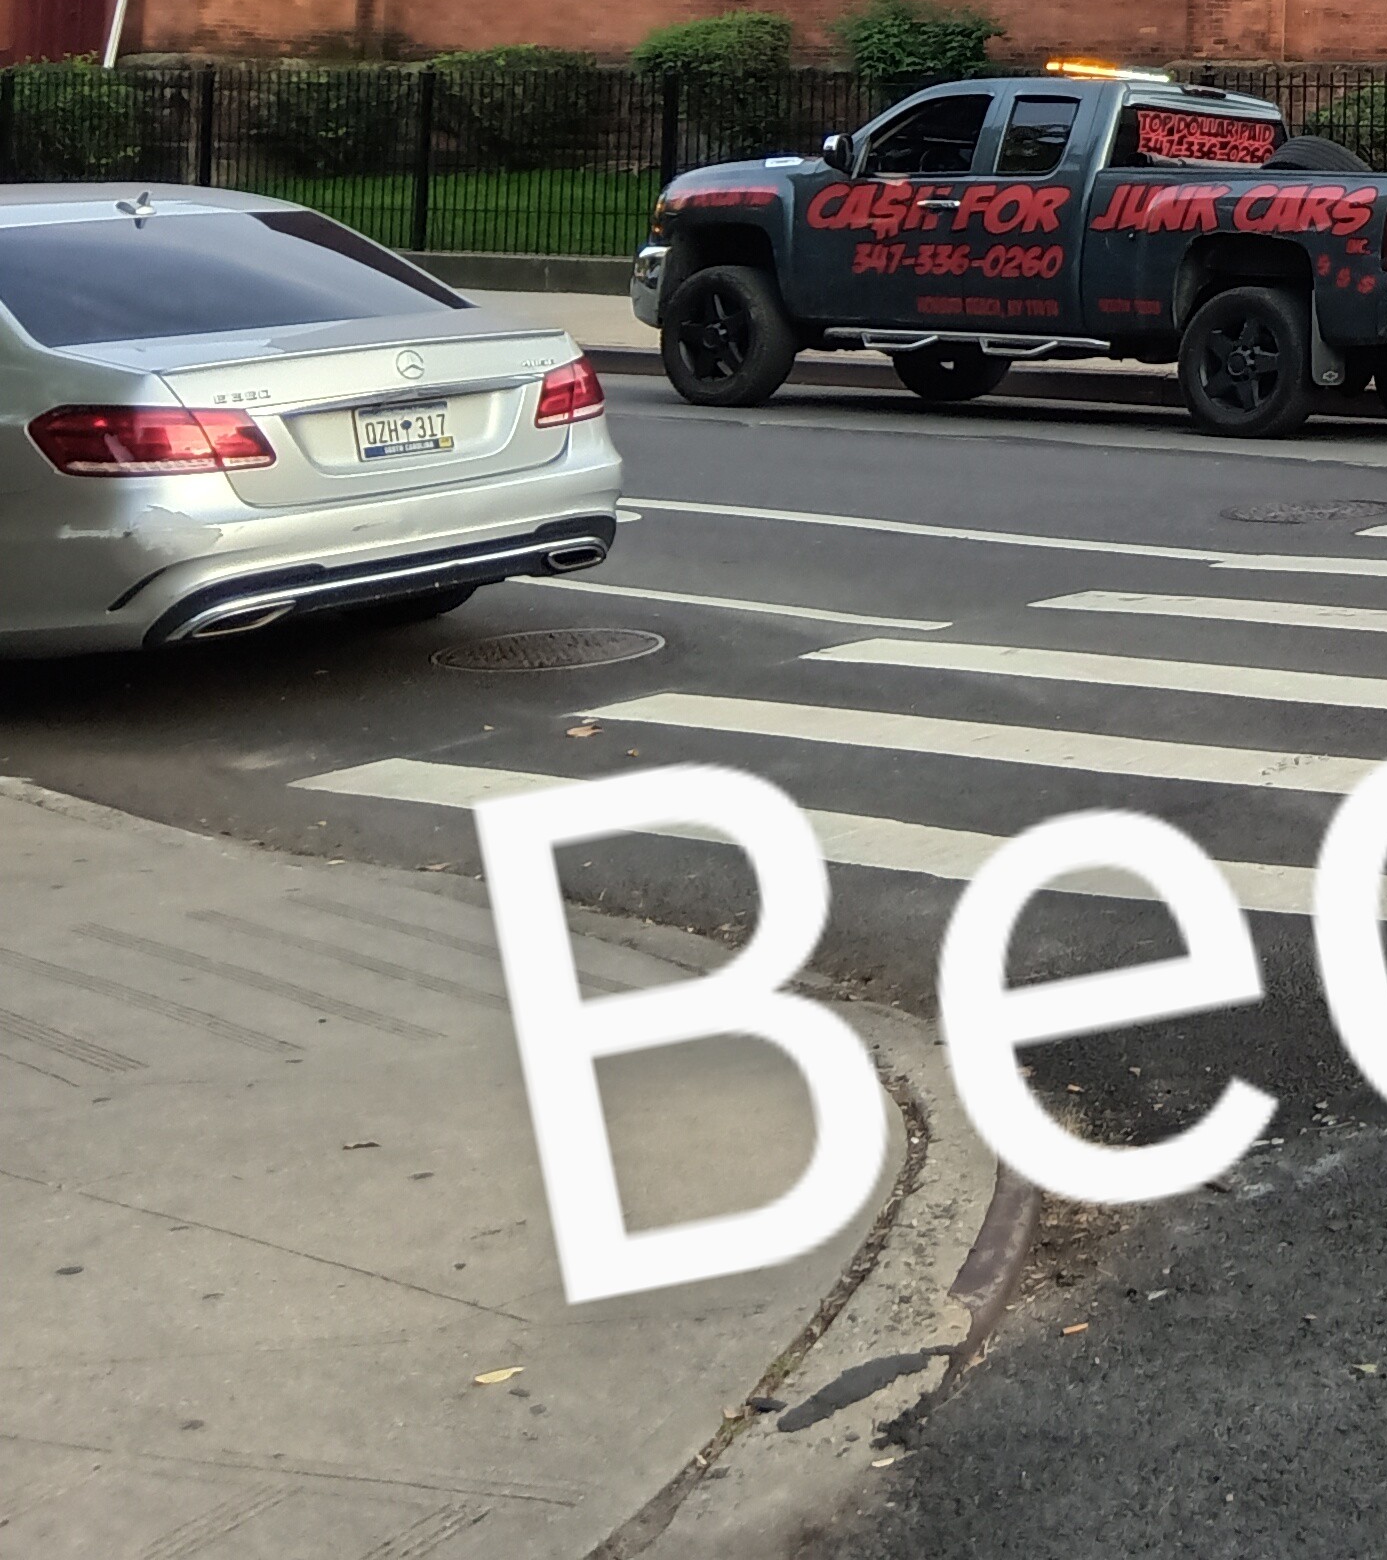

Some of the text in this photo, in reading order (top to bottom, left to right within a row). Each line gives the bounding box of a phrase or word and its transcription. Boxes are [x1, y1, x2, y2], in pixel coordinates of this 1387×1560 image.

[1137, 111, 1275, 145] TOP DOLLAR PAID
[952, 184, 1072, 235] FOR
[1089, 183, 1232, 234] JUNK
[1232, 183, 1379, 237] CARS
[852, 242, 1066, 279] 347-336-0260
[415, 413, 446, 439] 317
[404, 440, 435, 452] CAROLINA
